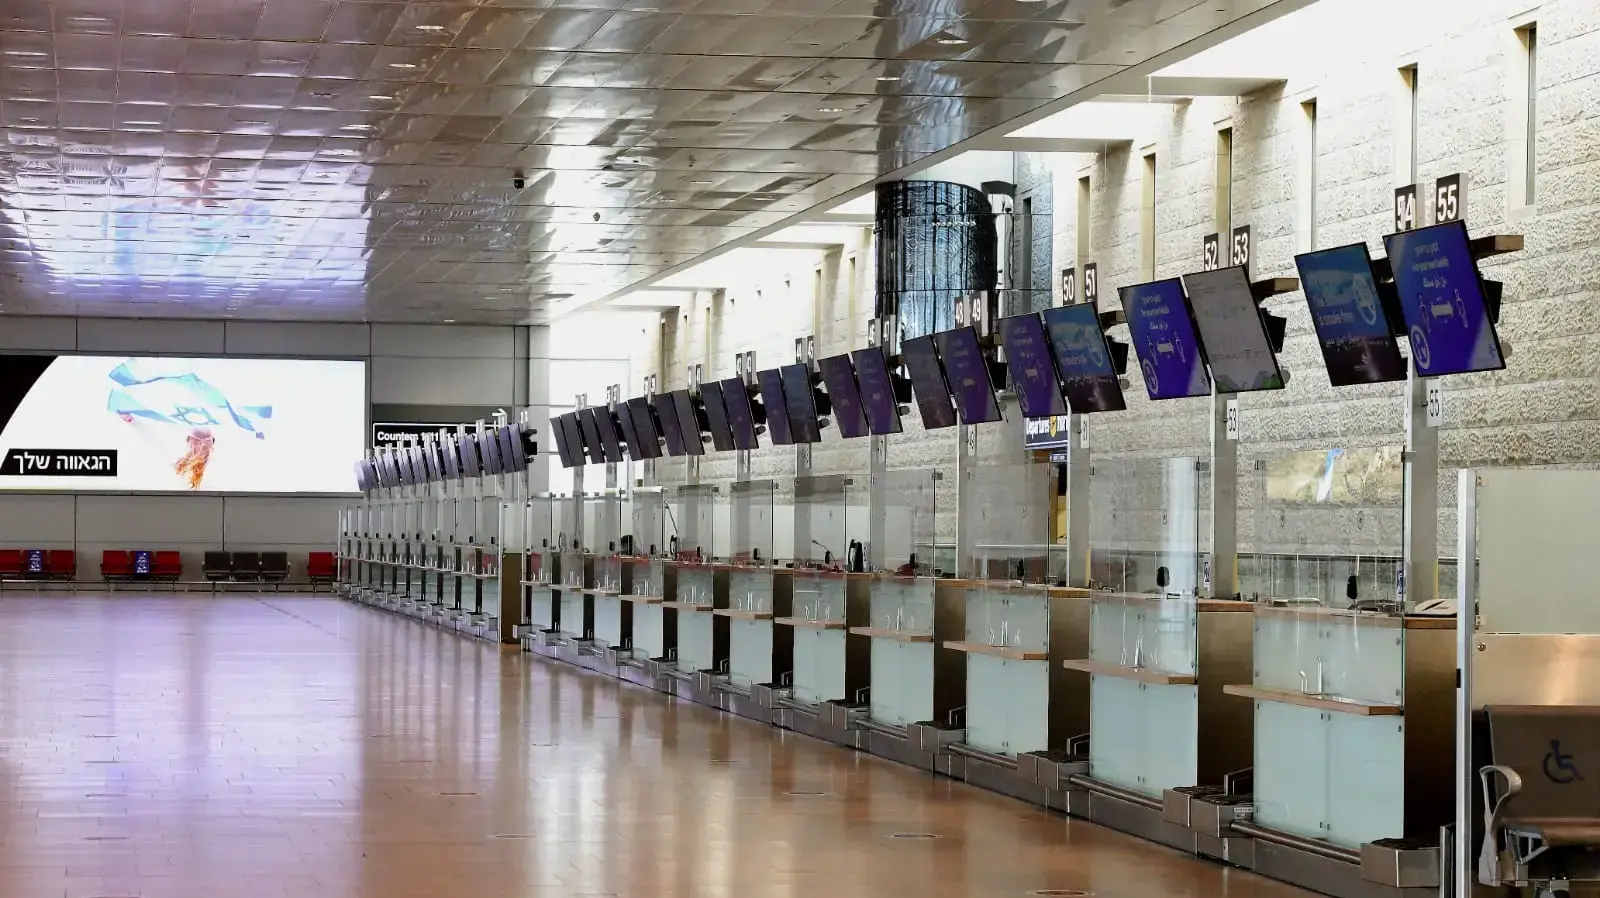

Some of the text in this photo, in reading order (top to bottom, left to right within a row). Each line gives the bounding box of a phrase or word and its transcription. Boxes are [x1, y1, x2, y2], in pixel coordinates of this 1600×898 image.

[1437, 184, 1457, 222] 55
[1204, 240, 1218, 270] 52
[1233, 232, 1248, 265] 53
[1063, 274, 1074, 302] 50
[1085, 268, 1096, 297] 51
[1429, 388, 1440, 418] 55
[1229, 407, 1237, 433] 53
[13, 451, 111, 474] הגאווה שלך
